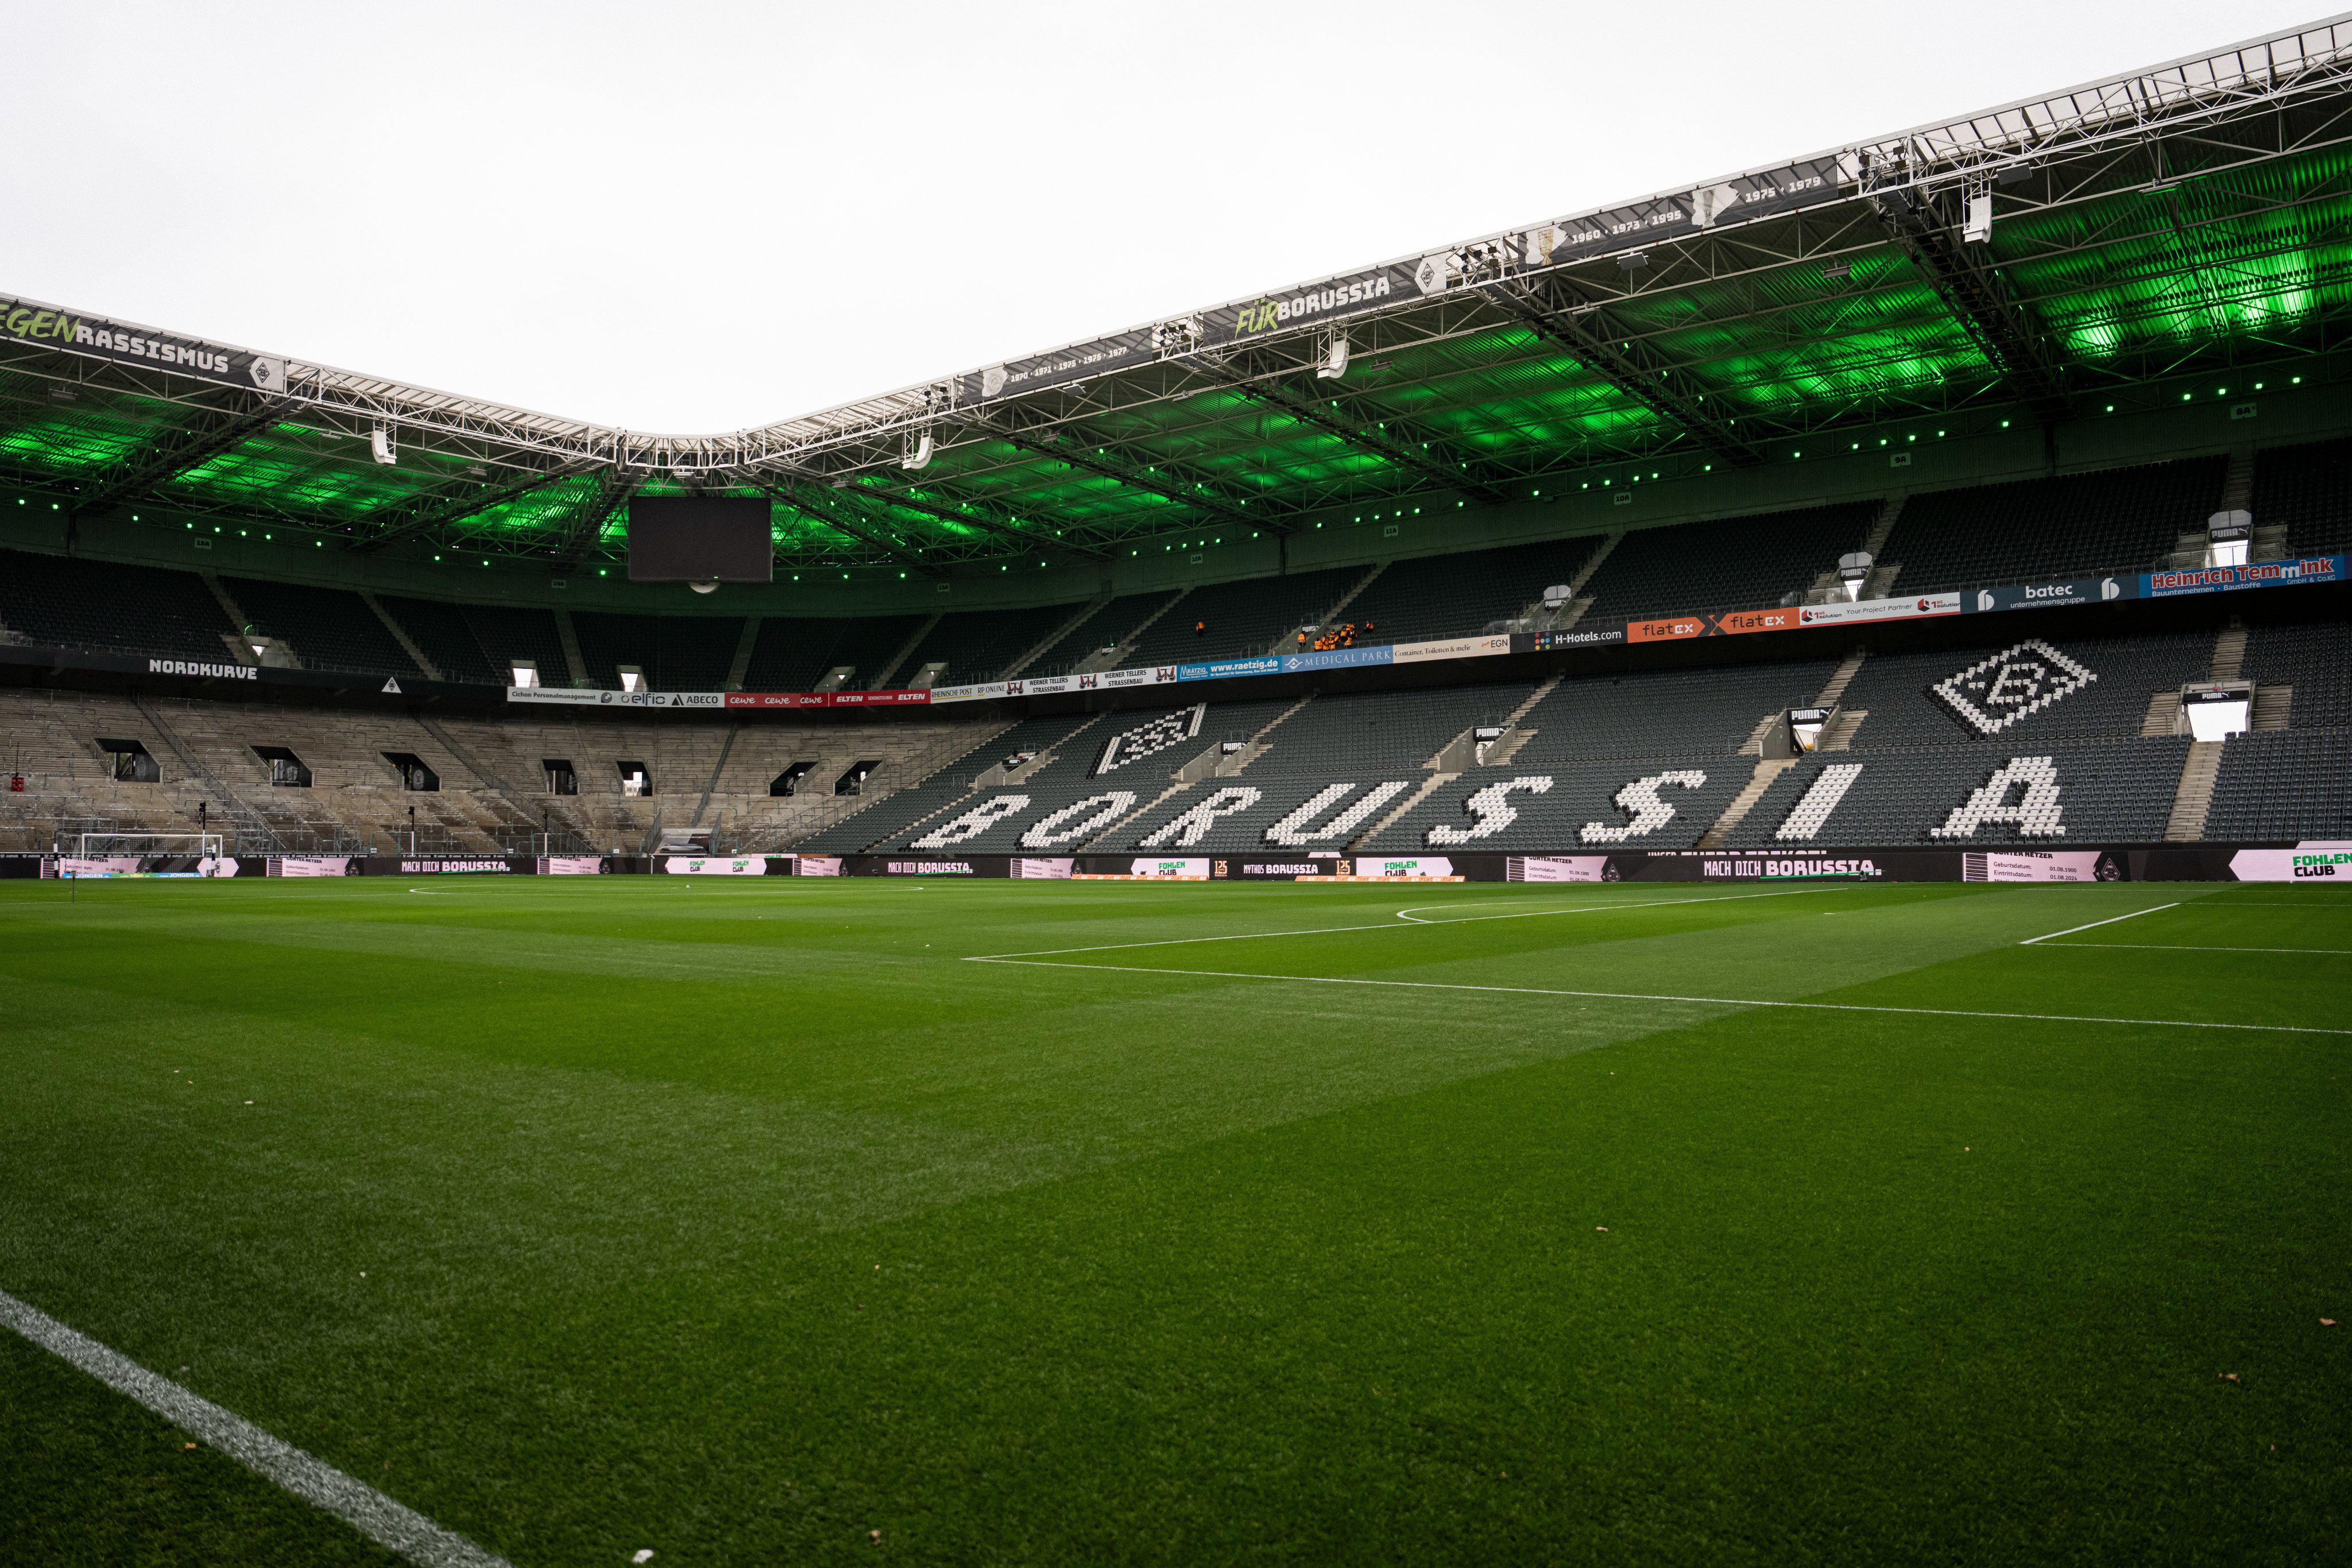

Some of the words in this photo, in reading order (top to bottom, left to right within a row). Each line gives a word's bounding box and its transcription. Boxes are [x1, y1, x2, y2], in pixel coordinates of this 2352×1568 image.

[1745, 187, 1775, 203] 1975
[1789, 176, 1821, 192] 1979
[1572, 229, 1600, 244] 1960
[1612, 220, 1640, 235] 1973
[1652, 210, 1681, 225] 1995
[1011, 372, 1028, 383] 1970
[1035, 365, 1052, 376] 1971
[1058, 359, 1076, 370] 1975
[1083, 353, 1101, 365] 1976
[1108, 346, 1127, 359] 1977
[2212, 528, 2238, 539] PUMA
[1841, 568, 1862, 577] PUMA
[2152, 567, 2234, 589] Heinrich
[2236, 557, 2335, 582] Temmink
[2025, 584, 2072, 599] batec
[2152, 586, 2214, 597] Bauunternehmen
[2223, 581, 2261, 592] Baustoffe
[2287, 577, 2307, 585] GmbH
[2010, 597, 2085, 609] unternehmensgruppe
[1863, 606, 1886, 614] Project
[1556, 631, 1622, 644] H-Hotels.com
[1491, 639, 1508, 648] EGN
[1395, 649, 1423, 657] Container,
[1425, 646, 1450, 655] Toiletten
[1305, 652, 1356, 667] MEDICAL
[1362, 650, 1391, 661] PARK
[149, 660, 257, 680] NORDKURVE
[1210, 659, 1278, 672] www.raetzig.de
[1108, 678, 1143, 686] STRASSENBAU
[986, 684, 1005, 692] ONLINE
[931, 690, 959, 698] RHEINISCHE
[687, 696, 718, 704] ABECO
[1792, 709, 1820, 720] PUMA
[1476, 727, 1499, 737] PUMA
[1223, 742, 1241, 751] PUMA
[1384, 860, 1417, 870] FOHLEN
[2293, 853, 2352, 866] FOHLEN
[401, 861, 420, 872] MACH
[422, 861, 439, 872] DICH
[442, 861, 510, 872] BORUSSIA.
[888, 862, 902, 873] MACH
[903, 862, 916, 873] DICH
[918, 862, 973, 873] BORUSSIA.
[1159, 861, 1186, 870] FOHLEN
[1215, 860, 1228, 874] 125
[1244, 864, 1264, 874] MYTHOS
[1266, 864, 1318, 874] BORUSSIA
[1336, 860, 1351, 874] 125
[1704, 860, 1731, 876] MACH
[1735, 860, 1761, 876] DICH
[1766, 860, 1882, 876] BORUSSIA.
[1994, 862, 2032, 870] Geburtsdatum:
[2294, 865, 2335, 877] CLUB
[1994, 870, 2033, 878] Eintrittsdatum:
